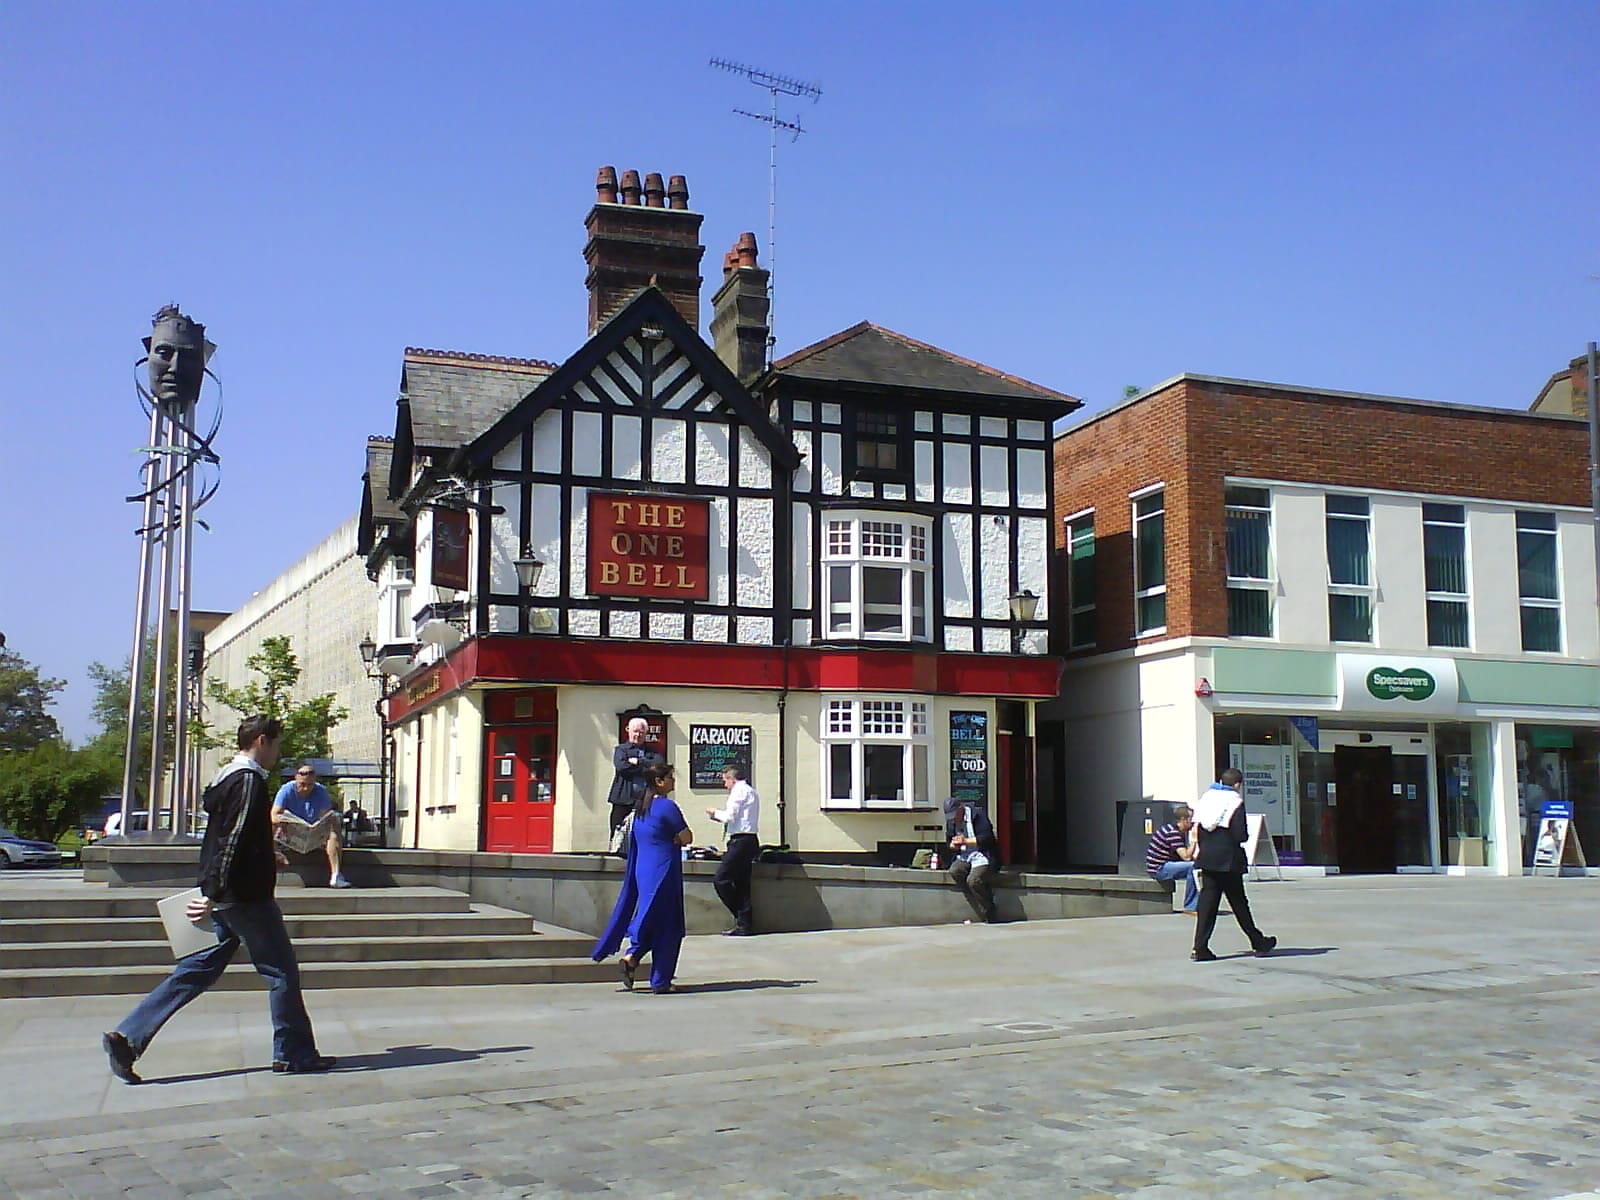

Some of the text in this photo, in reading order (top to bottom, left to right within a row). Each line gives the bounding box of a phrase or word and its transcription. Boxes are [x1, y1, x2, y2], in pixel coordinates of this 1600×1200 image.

[611, 502, 685, 528] THE
[611, 532, 685, 558] ONE
[600, 561, 696, 588] BELL
[692, 727, 750, 745] KARAOKE
[952, 728, 985, 740] BELL
[952, 759, 986, 772] FOOD
